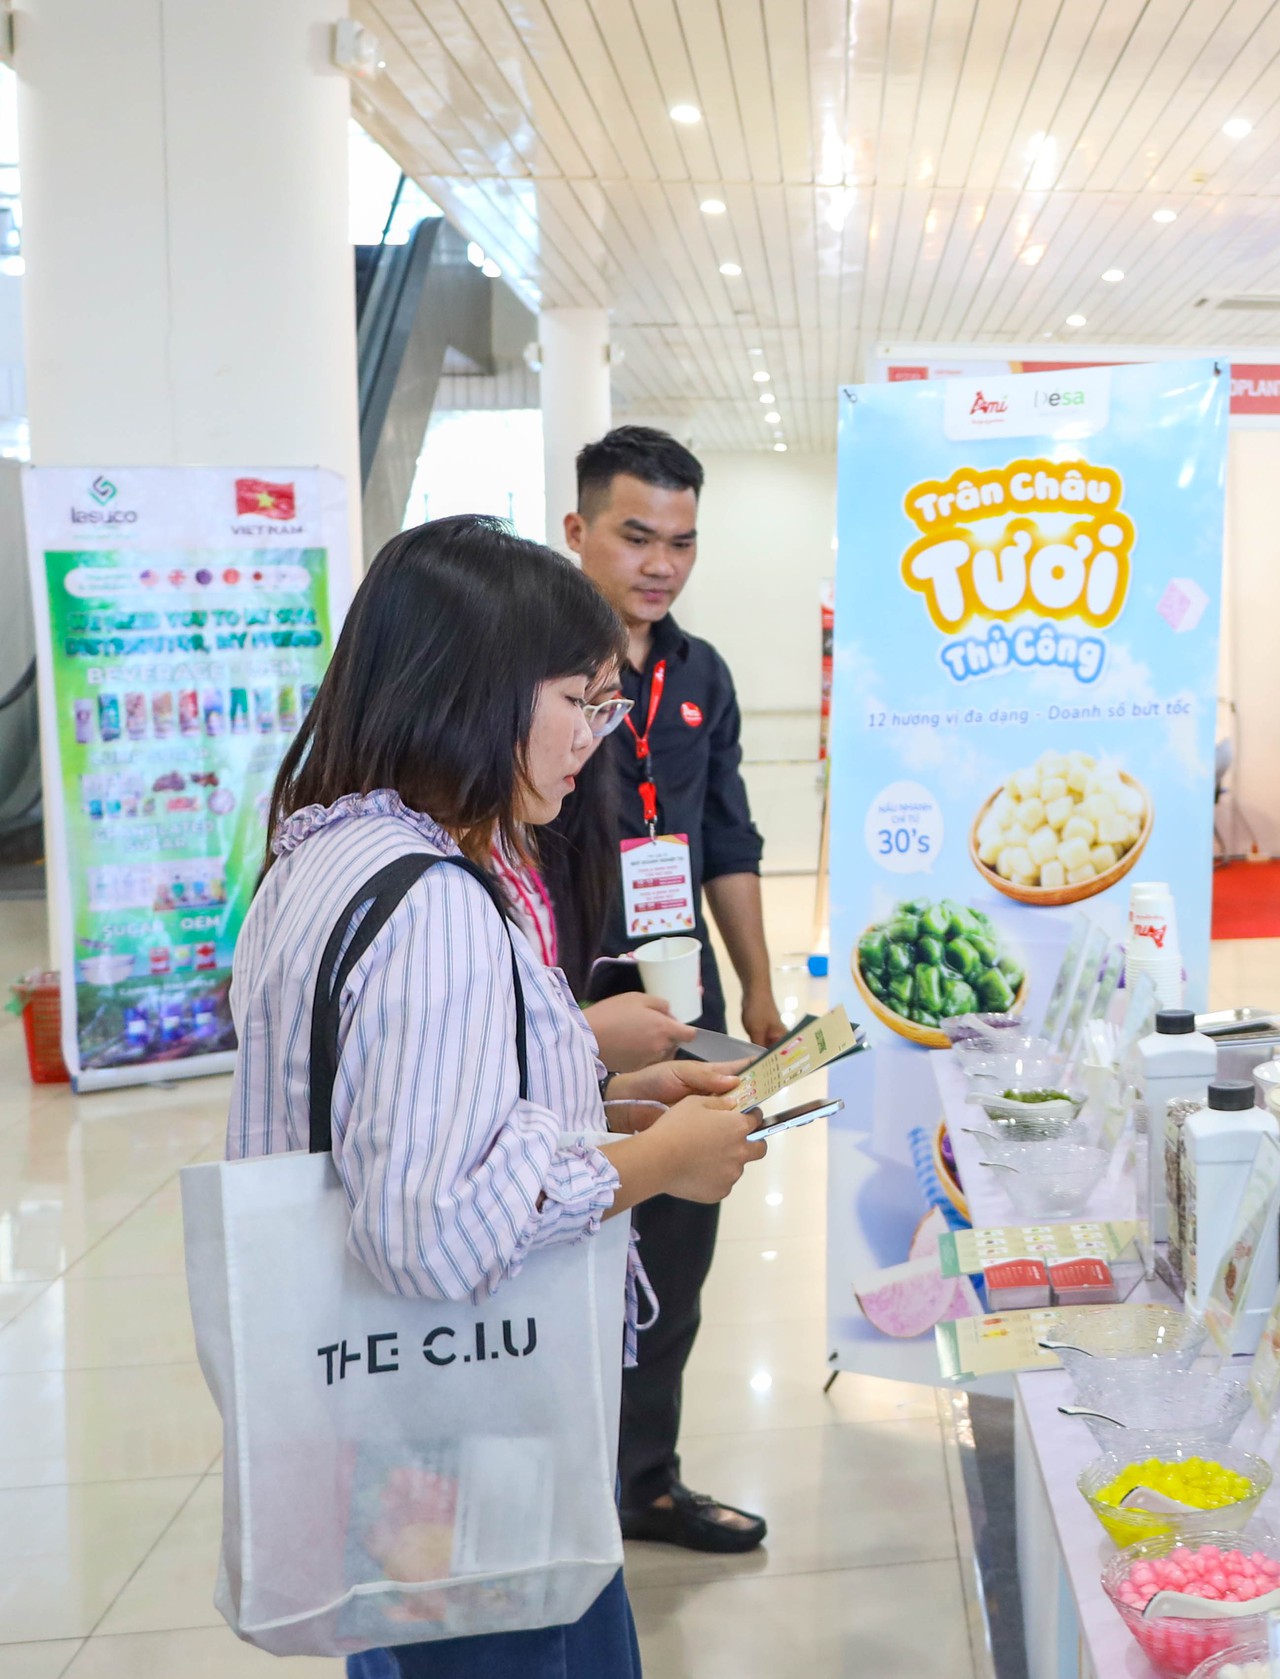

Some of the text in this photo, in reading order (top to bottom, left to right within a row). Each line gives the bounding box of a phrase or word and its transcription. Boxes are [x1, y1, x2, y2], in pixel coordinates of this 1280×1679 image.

[914, 470, 1111, 521] Trân Châu
[944, 626, 1102, 680] Thủ Công
[868, 713, 886, 727] 12
[892, 712, 940, 728] hương
[964, 709, 983, 723] đa
[989, 708, 1028, 725] dạng
[1048, 705, 1100, 719] Doanh
[878, 828, 930, 855] 30's
[318, 1332, 399, 1386] THE
